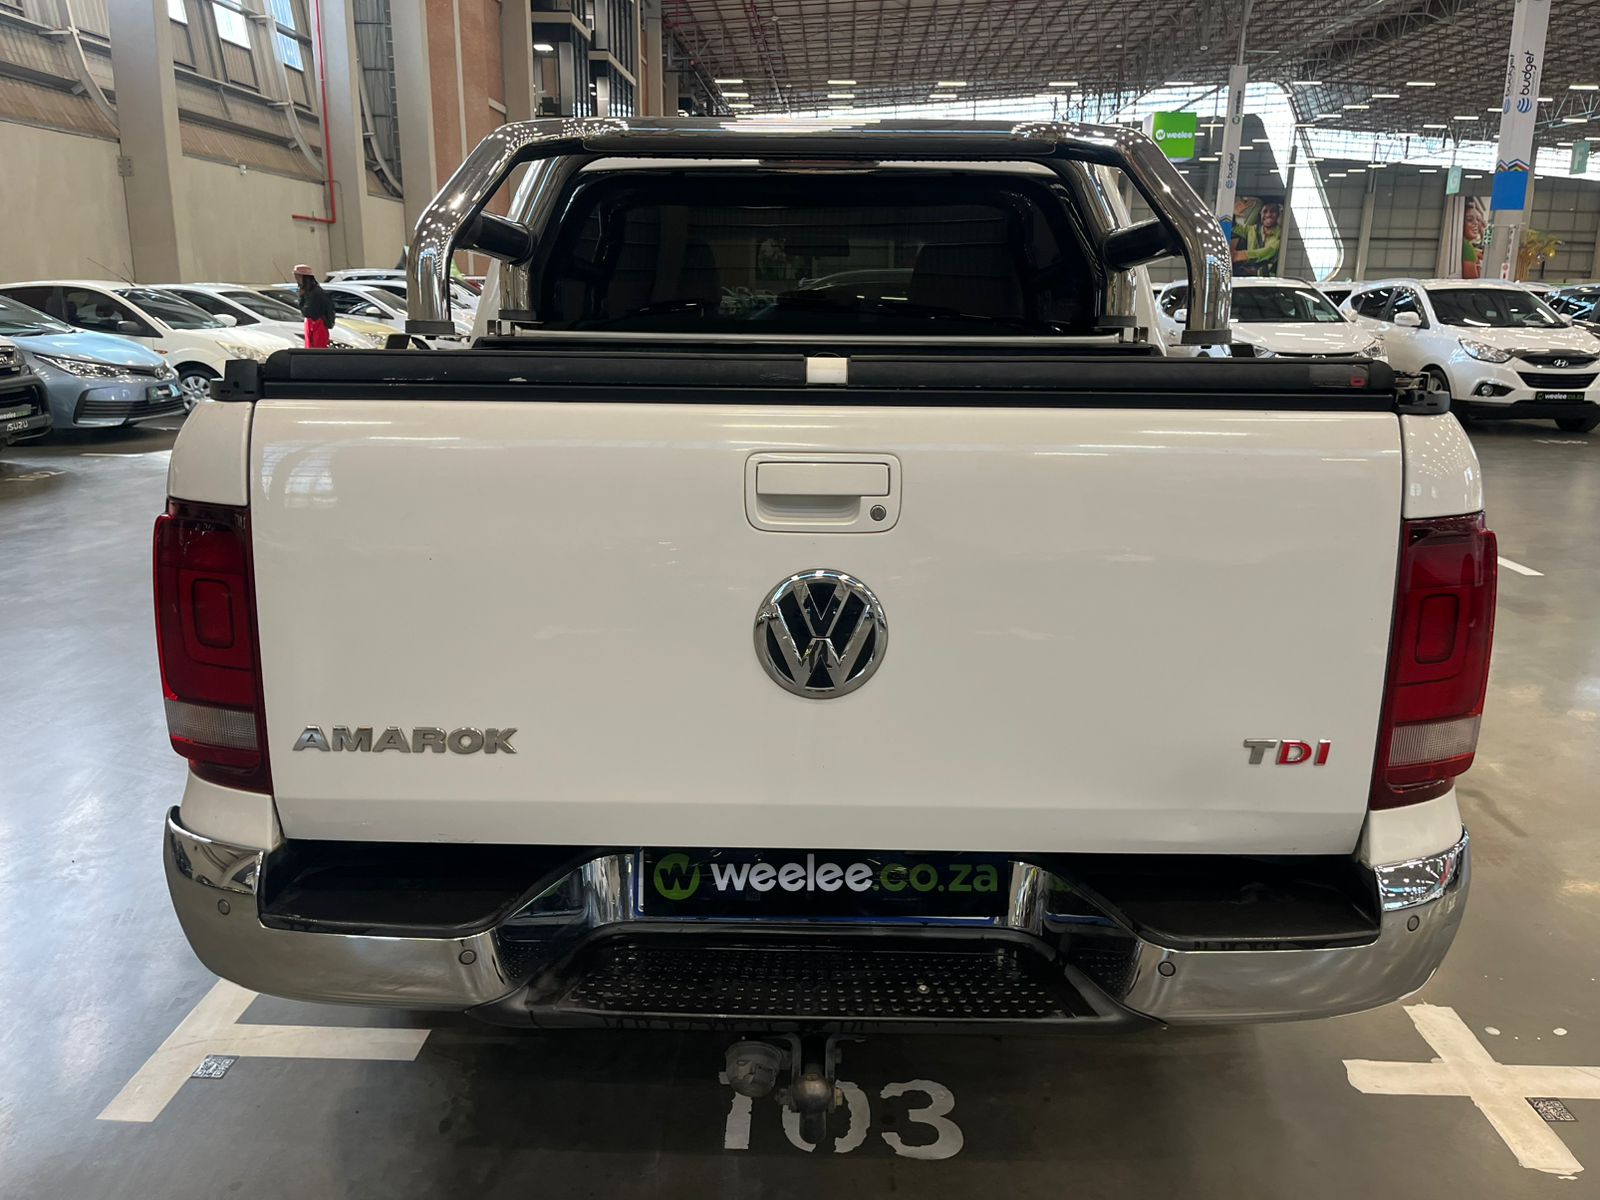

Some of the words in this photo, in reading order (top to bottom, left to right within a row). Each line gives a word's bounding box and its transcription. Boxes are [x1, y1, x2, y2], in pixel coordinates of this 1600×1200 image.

[1505, 54, 1516, 97] budget
[1519, 50, 1537, 95] budget
[1167, 130, 1193, 139] weelee
[1227, 152, 1237, 179] budget
[7, 420, 29, 432] ISUZU
[293, 725, 519, 755] AMAROK
[1243, 738, 1332, 767] TDI
[711, 853, 998, 893] weelee.co.za
